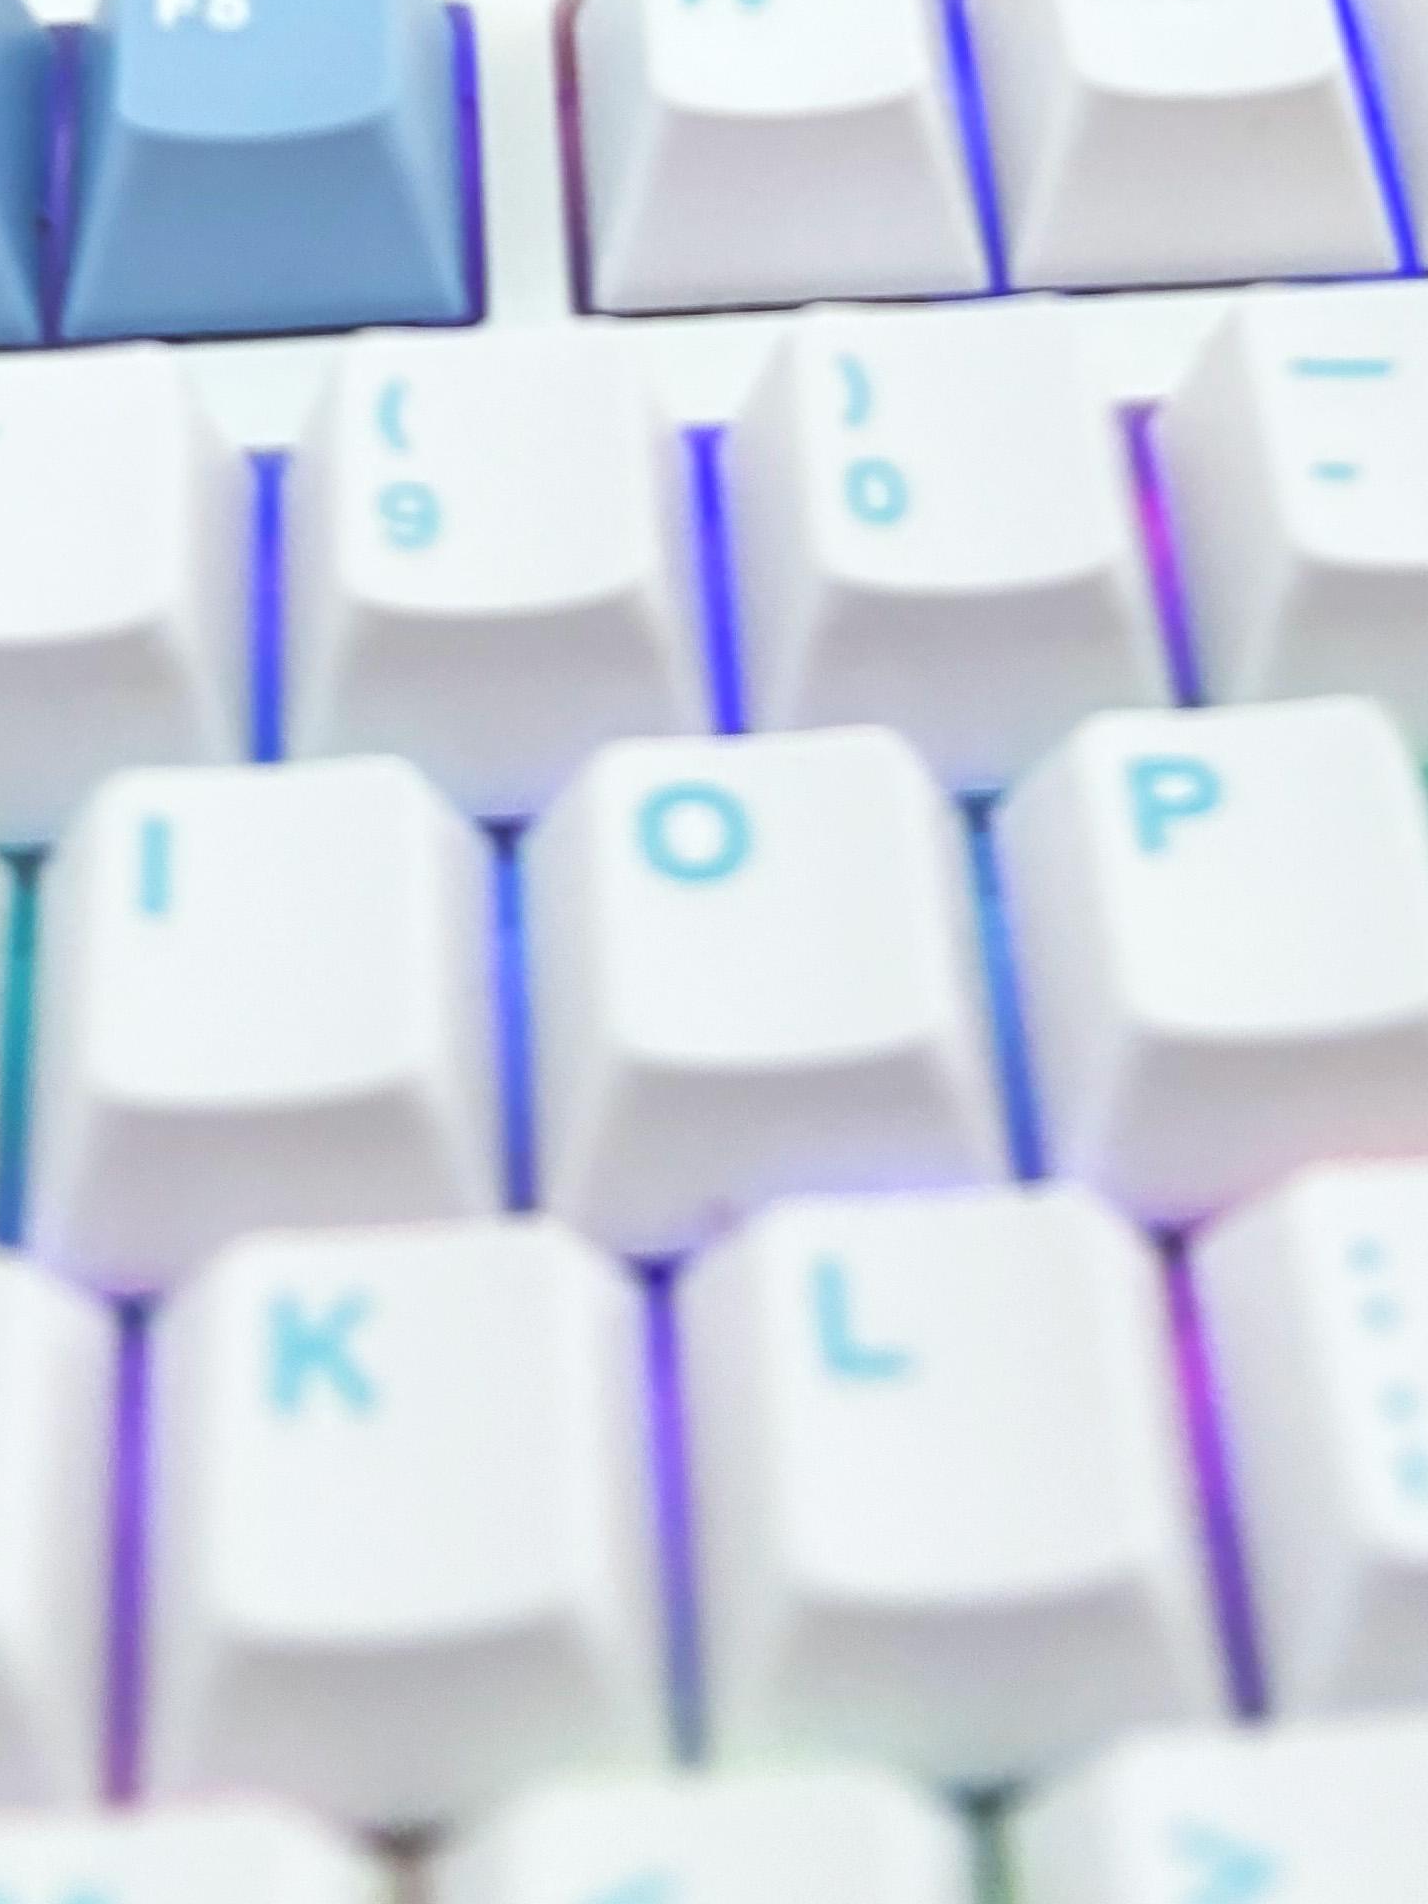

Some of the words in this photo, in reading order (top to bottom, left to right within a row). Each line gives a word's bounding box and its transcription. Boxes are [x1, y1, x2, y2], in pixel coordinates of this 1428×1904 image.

[377, 482, 443, 552] 9
[636, 781, 754, 886] O
[1126, 756, 1223, 854] P
[137, 817, 172, 918] I
[270, 1300, 374, 1411] K
[810, 1259, 912, 1383] L
